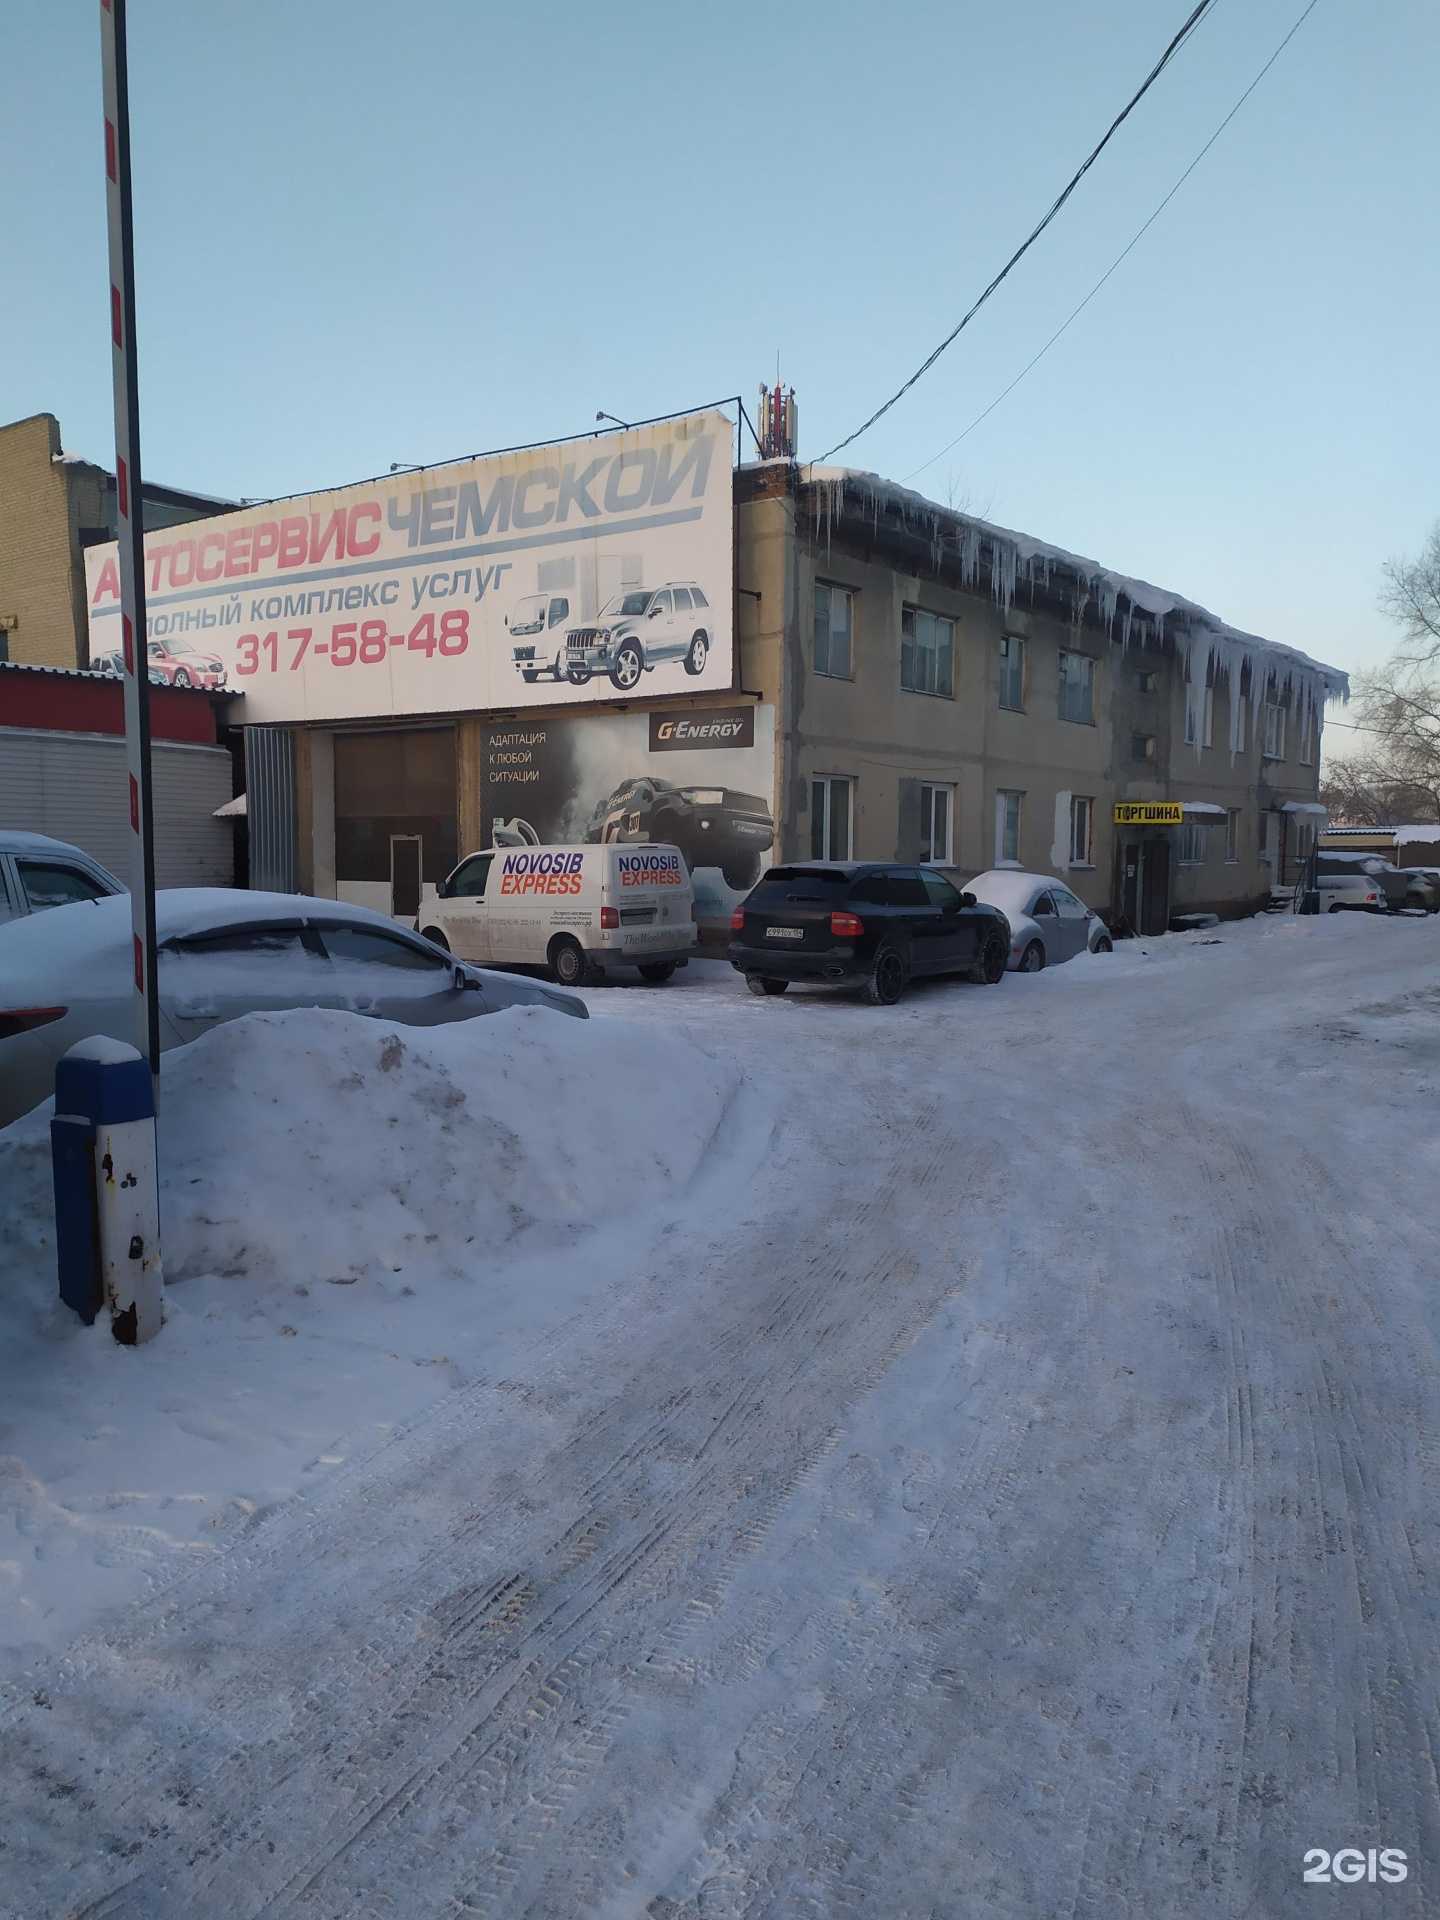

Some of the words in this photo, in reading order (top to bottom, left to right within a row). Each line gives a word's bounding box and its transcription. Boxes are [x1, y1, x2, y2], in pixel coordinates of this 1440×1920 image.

[92, 501, 381, 604] АТОСЕРВИС
[387, 417, 716, 548] ЧЕМСКОЙ
[235, 608, 470, 677] 317-58-48
[489, 732, 546, 746] АДАПТАЦИЯ
[497, 750, 532, 764] ЛЮБОЙ
[490, 770, 540, 784] СИТУАЦИИ
[1116, 806, 1180, 820] ТОРГШИНА
[502, 853, 583, 875] NOVOSIB
[618, 856, 679, 872] NOVOSIB
[501, 873, 582, 895] EXPRESS
[622, 870, 682, 886] EXPRESS
